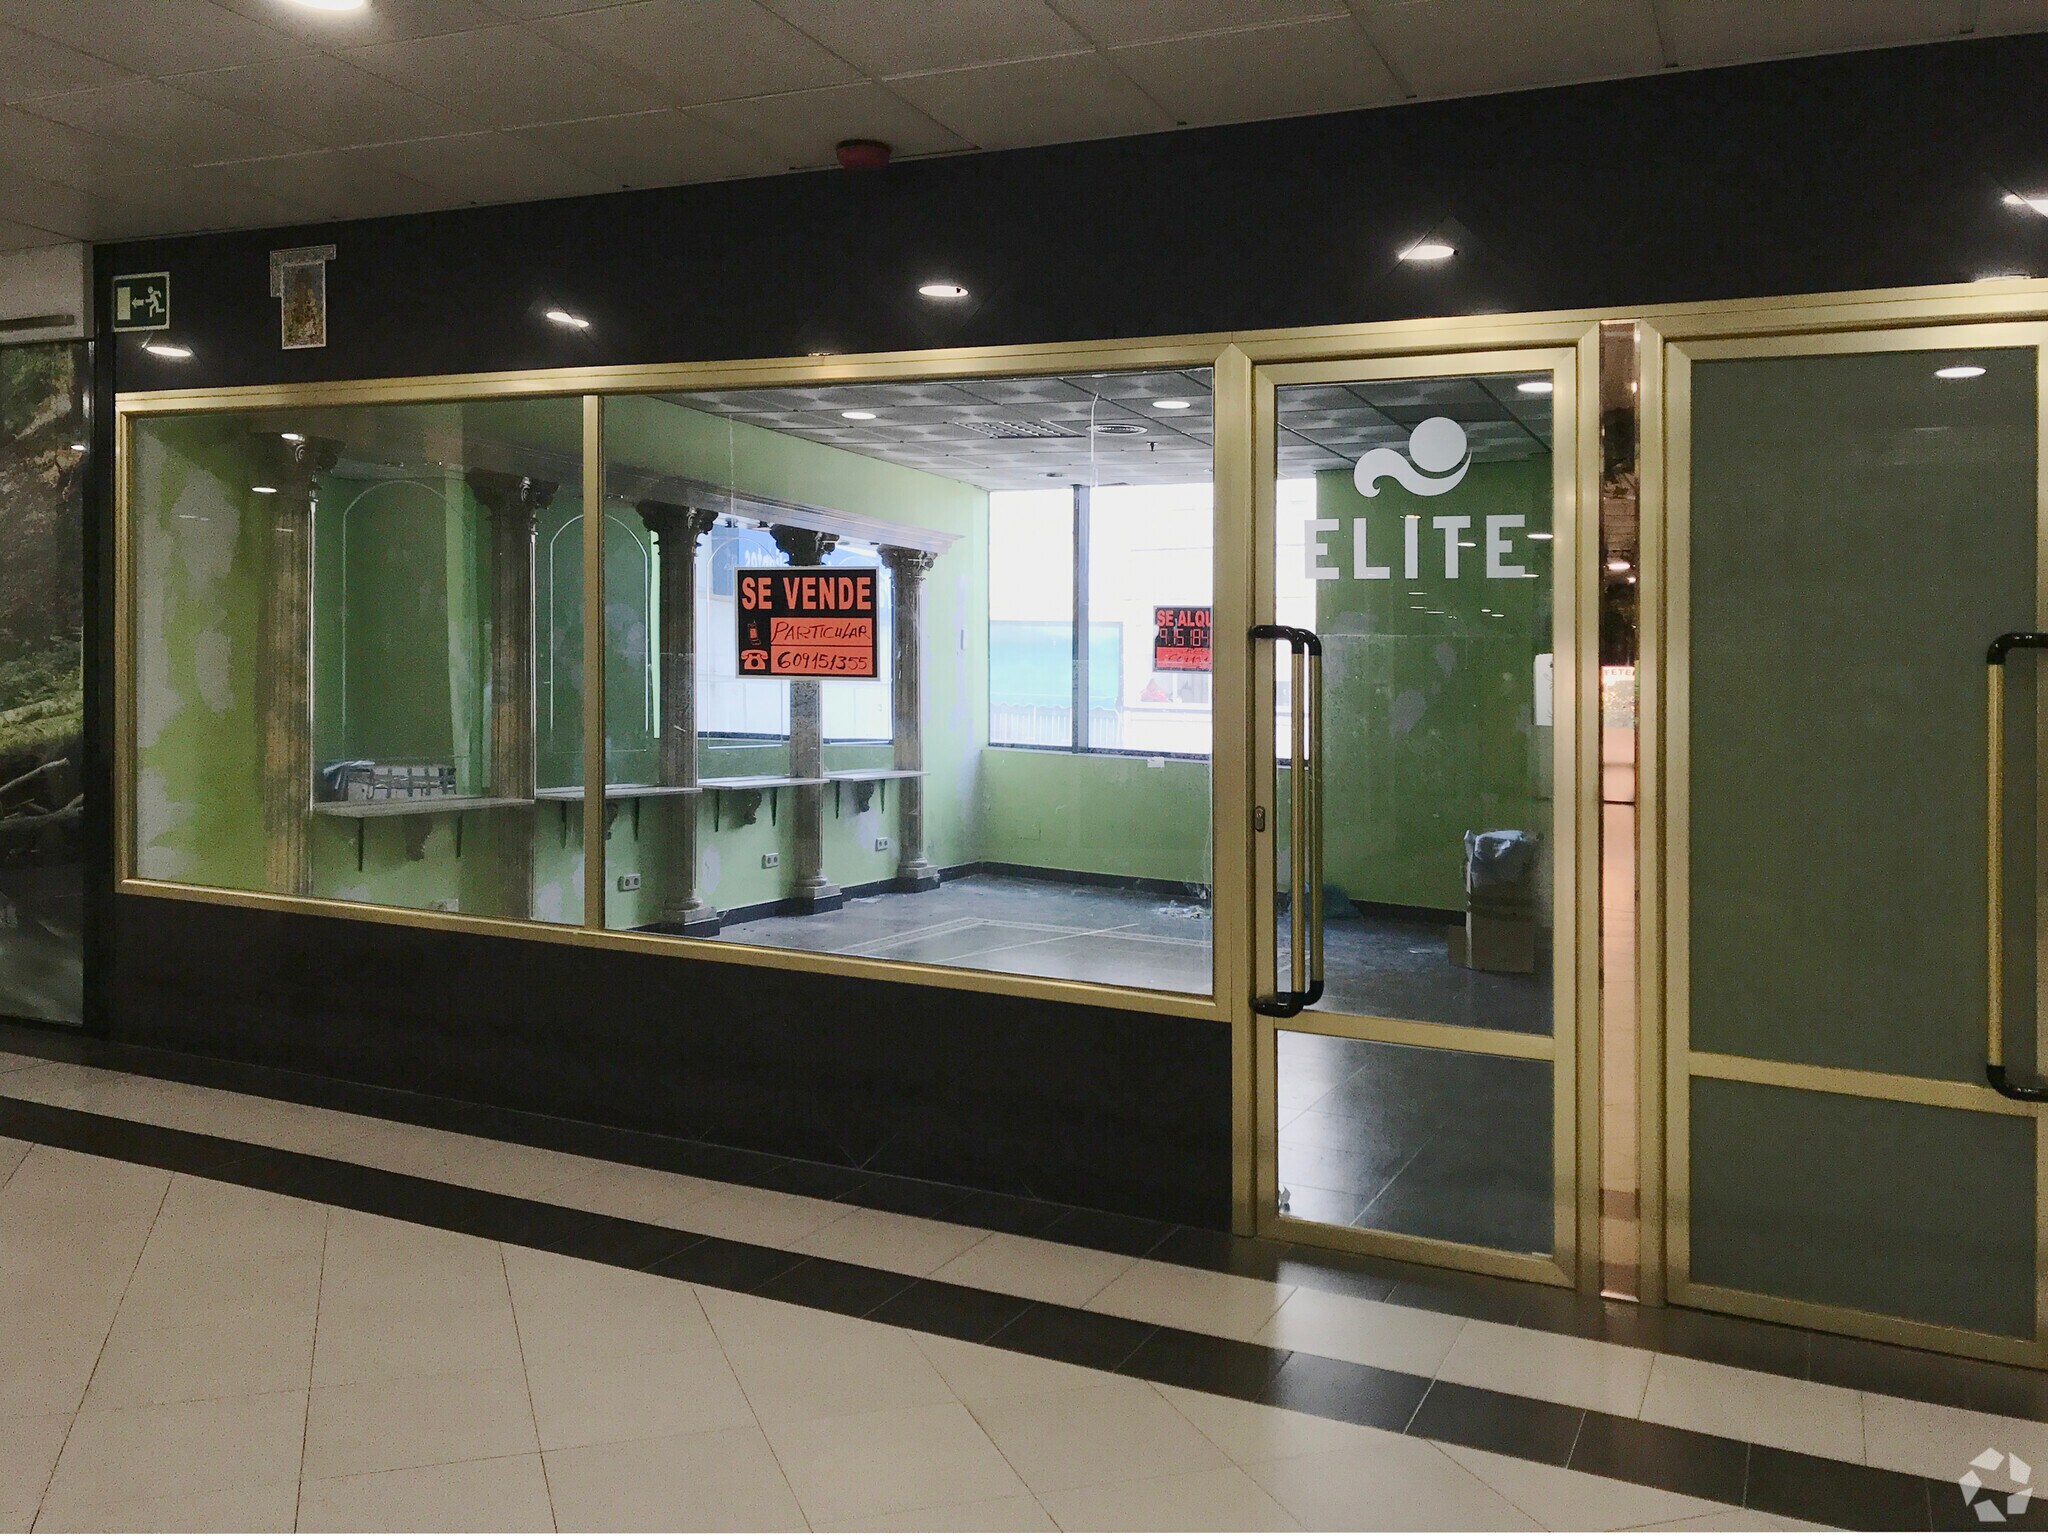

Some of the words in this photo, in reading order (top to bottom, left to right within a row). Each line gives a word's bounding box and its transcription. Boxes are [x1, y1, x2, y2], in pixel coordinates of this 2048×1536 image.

[1304, 514, 1526, 580] ELITE
[741, 576, 772, 611] SE
[783, 576, 872, 611] VENDE
[1156, 610, 1174, 627] SE
[771, 621, 871, 644] PARTICULAR
[777, 651, 868, 671] 609151355
